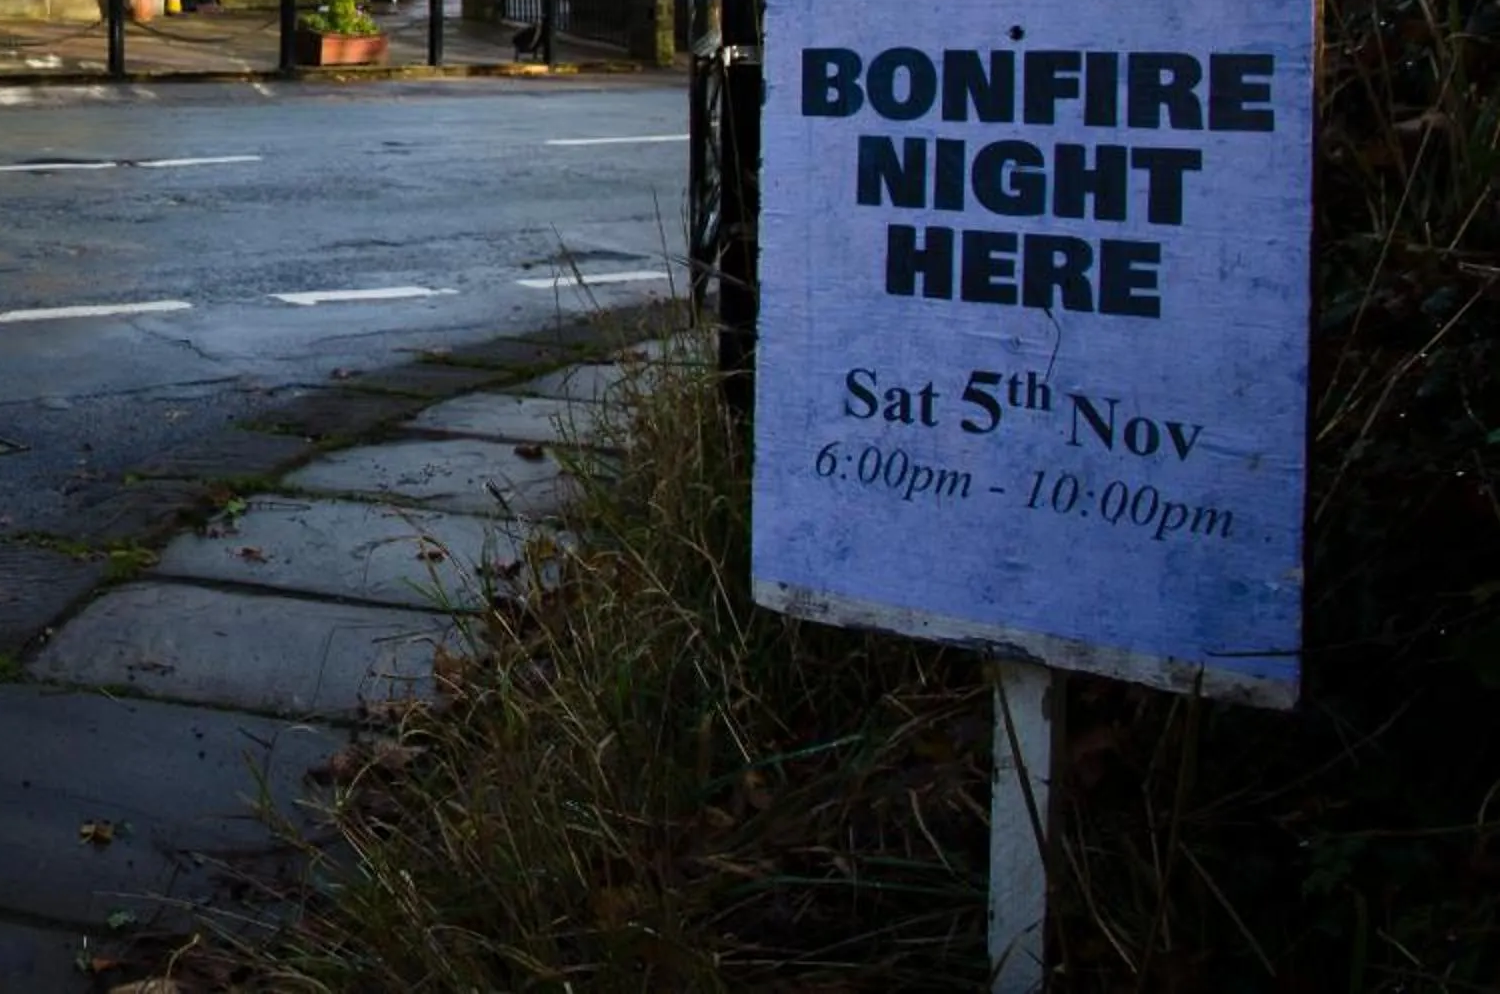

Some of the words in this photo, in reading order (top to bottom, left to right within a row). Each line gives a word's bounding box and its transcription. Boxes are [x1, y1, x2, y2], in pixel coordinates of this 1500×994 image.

[801, 46, 1275, 132] BONFIRE
[856, 135, 1203, 226] NIGHT
[886, 223, 1161, 319] HERE
[844, 367, 940, 428] Sat
[959, 369, 1052, 435] 5th
[1065, 392, 1204, 461] Nov
[815, 440, 972, 503] 6:00pm
[988, 487, 1005, 495] -
[1025, 469, 1234, 541] 10:00pm
